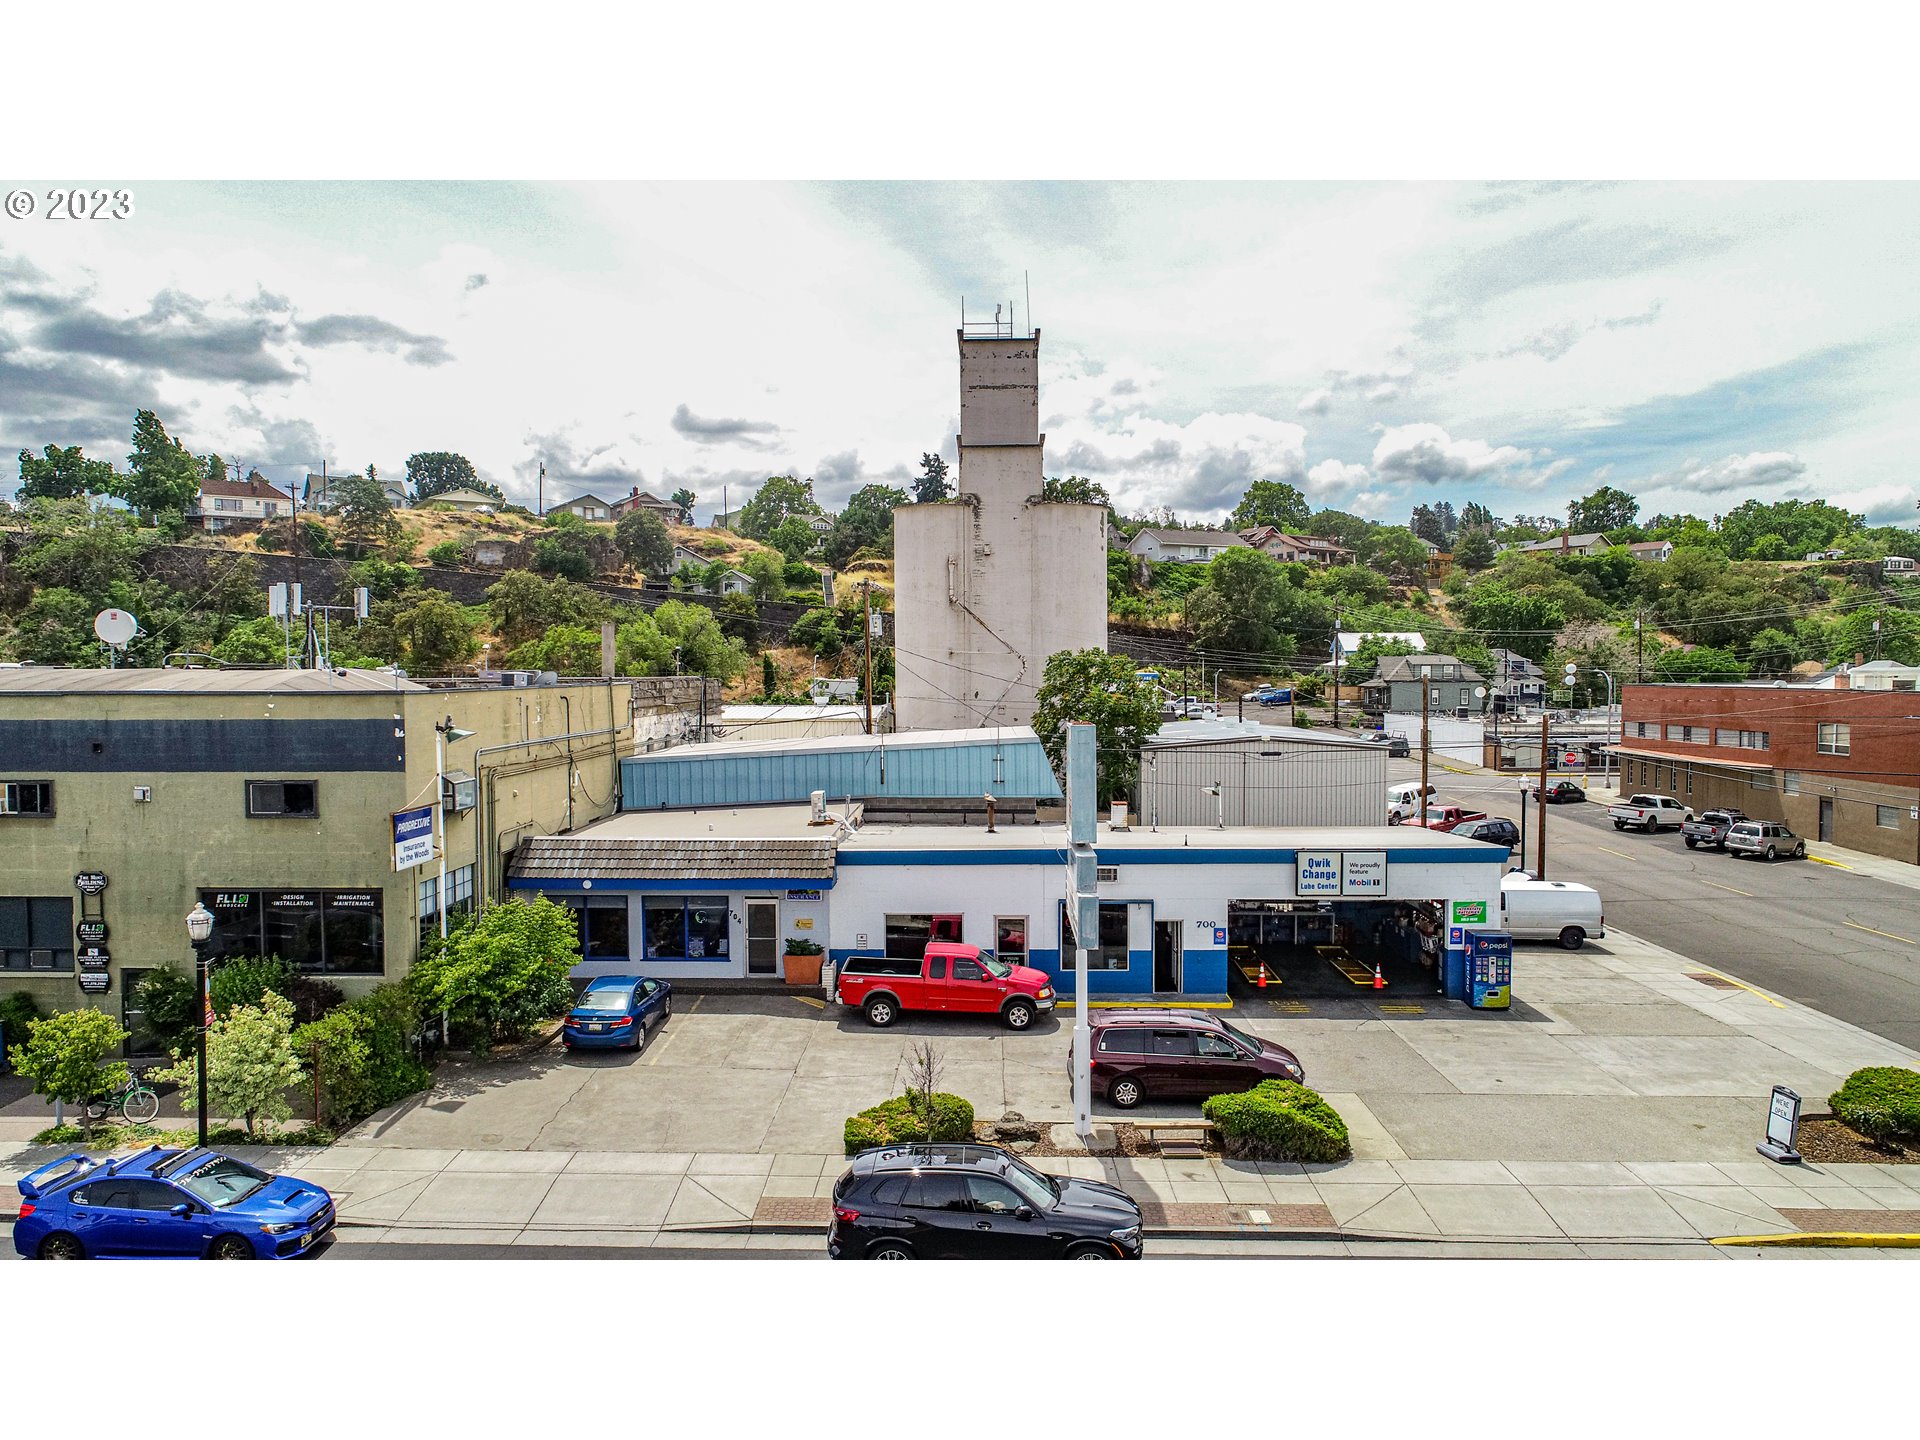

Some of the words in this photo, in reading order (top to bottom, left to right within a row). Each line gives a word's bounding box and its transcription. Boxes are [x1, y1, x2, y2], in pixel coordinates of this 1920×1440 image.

[396, 816, 431, 834] PROGRESSIVE
[403, 841, 426, 852] Insurance
[414, 849, 430, 858] Woods
[1307, 858, 1331, 869] Qwik
[1302, 869, 1337, 880] Change
[729, 910, 742, 925] 704
[1196, 920, 1217, 929] 700
[1489, 942, 1508, 950] pepsi
[1774, 1107, 1787, 1117] OPEN
